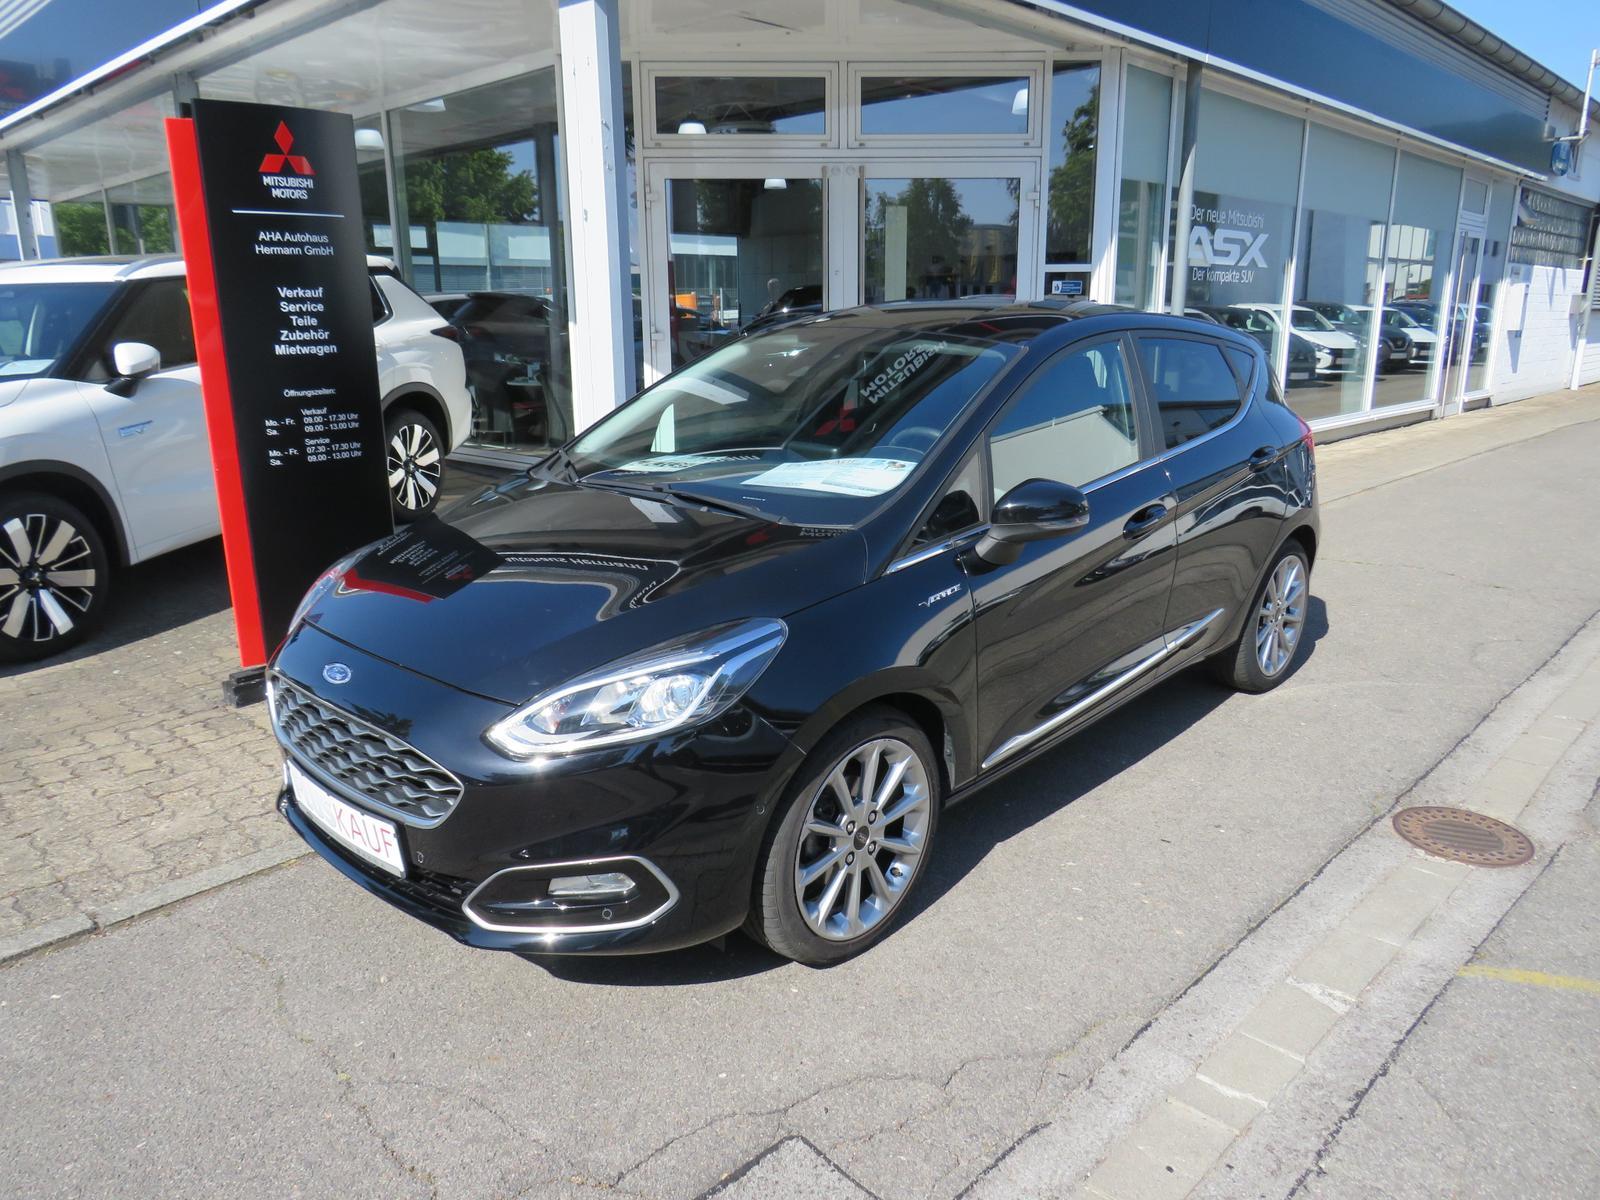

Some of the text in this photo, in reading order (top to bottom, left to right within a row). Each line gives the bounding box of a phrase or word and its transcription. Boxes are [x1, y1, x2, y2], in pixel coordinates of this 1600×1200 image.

[262, 176, 314, 188] MITSUBISHI
[271, 188, 308, 199] MOTORS
[1191, 204, 1265, 229] Der neue Mitsubishi
[258, 231, 329, 243] AHA Autohaus
[255, 244, 334, 256] Hermann GmbH
[1188, 225, 1269, 268] ASX
[1192, 267, 1255, 285] Der kompakte SUV
[278, 286, 323, 299] Verkauf
[280, 302, 324, 313] Service
[290, 315, 318, 327] Teile
[280, 330, 330, 341] Zubehör
[274, 345, 337, 356] Mietwagen
[301, 407, 327, 415] Verkauf
[285, 418, 296, 426] Fr.
[303, 416, 323, 424] 09.00
[329, 414, 346, 422] 17.30
[266, 428, 280, 436] Sa.
[305, 424, 324, 432] 09.00
[330, 422, 347, 430] 13.00
[305, 438, 330, 446] Service
[306, 445, 326, 454] 07.30
[331, 443, 349, 451] 17.30
[307, 454, 327, 463] 09.00
[332, 451, 350, 460] 13.00
